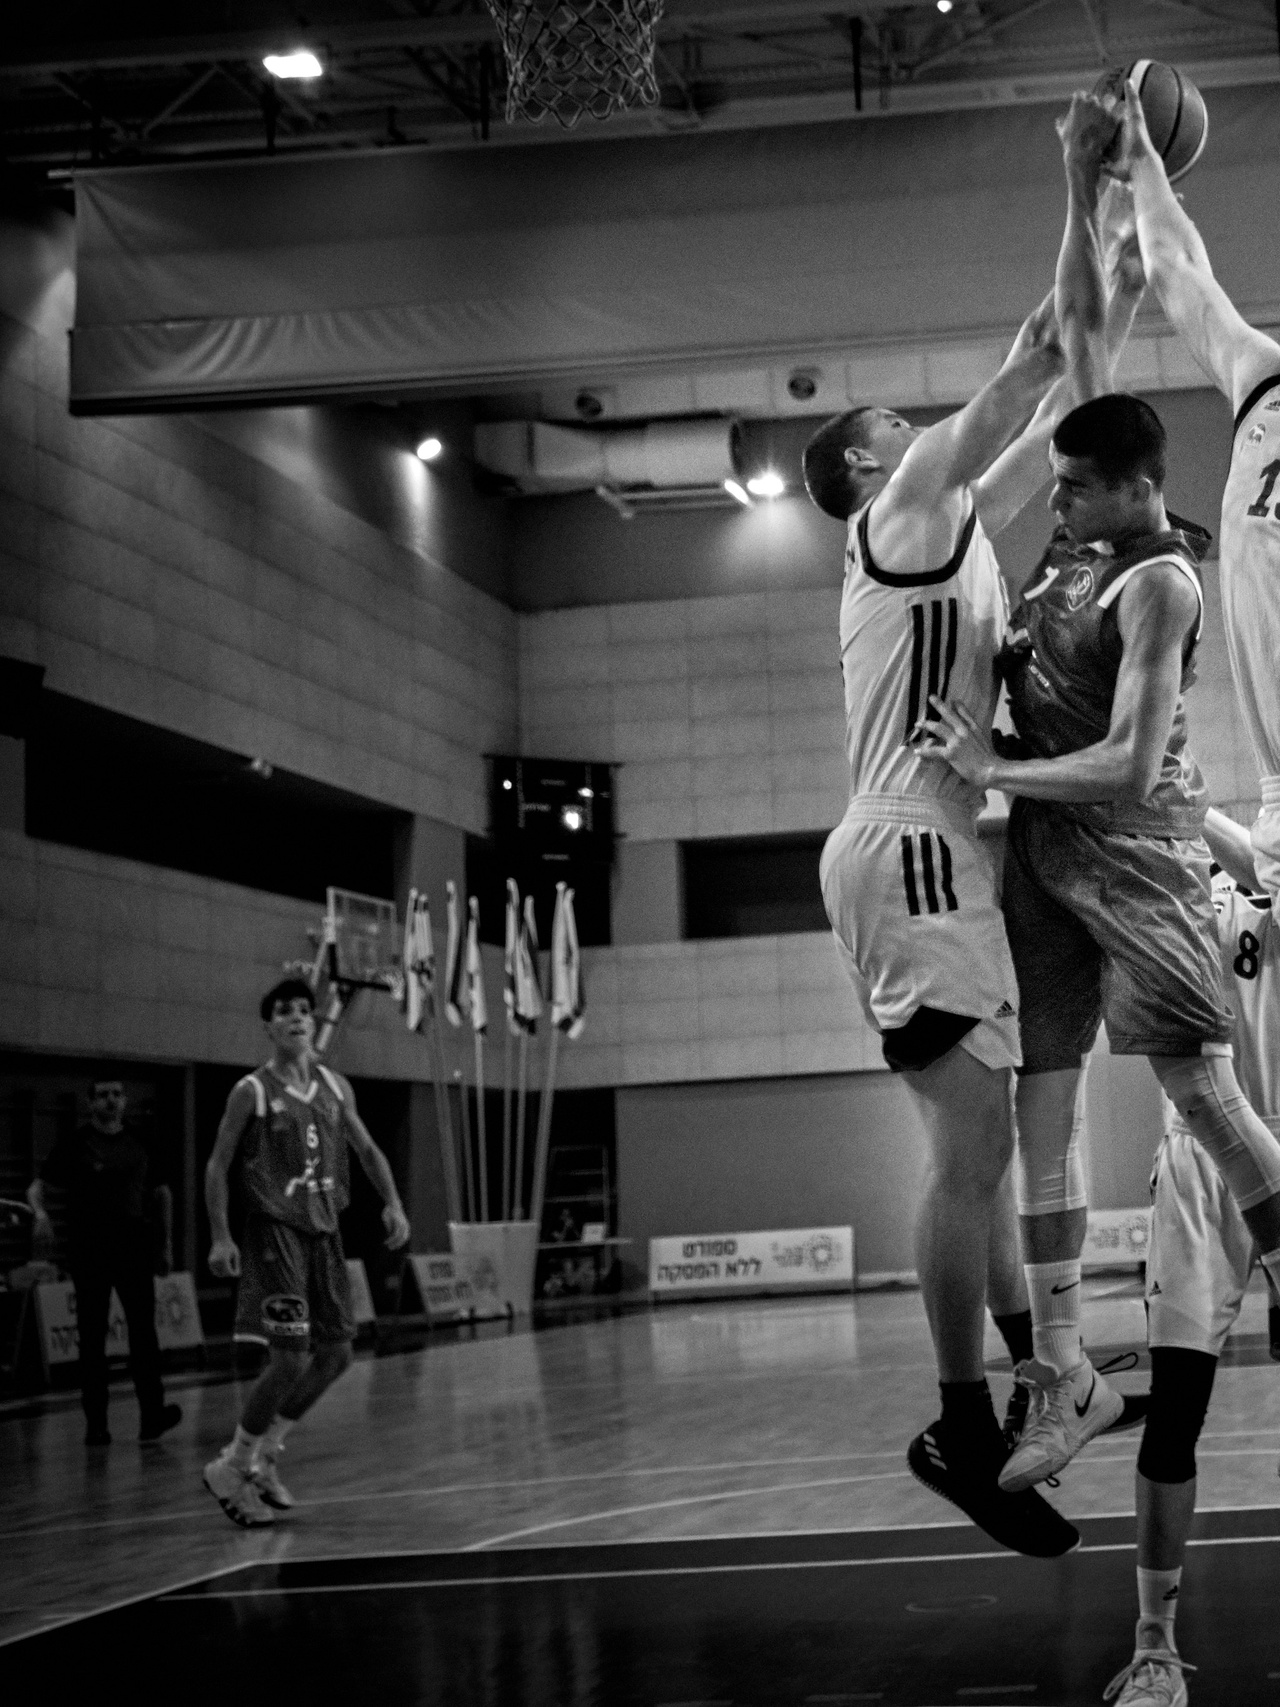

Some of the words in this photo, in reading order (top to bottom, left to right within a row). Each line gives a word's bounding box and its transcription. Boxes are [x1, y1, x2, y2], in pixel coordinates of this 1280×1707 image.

[1233, 930, 1260, 980] 8
[305, 1123, 319, 1149] 6
[682, 1239, 738, 1259] ספורט
[657, 1262, 720, 1284] הפסקה
[725, 1256, 762, 1278] ללא
